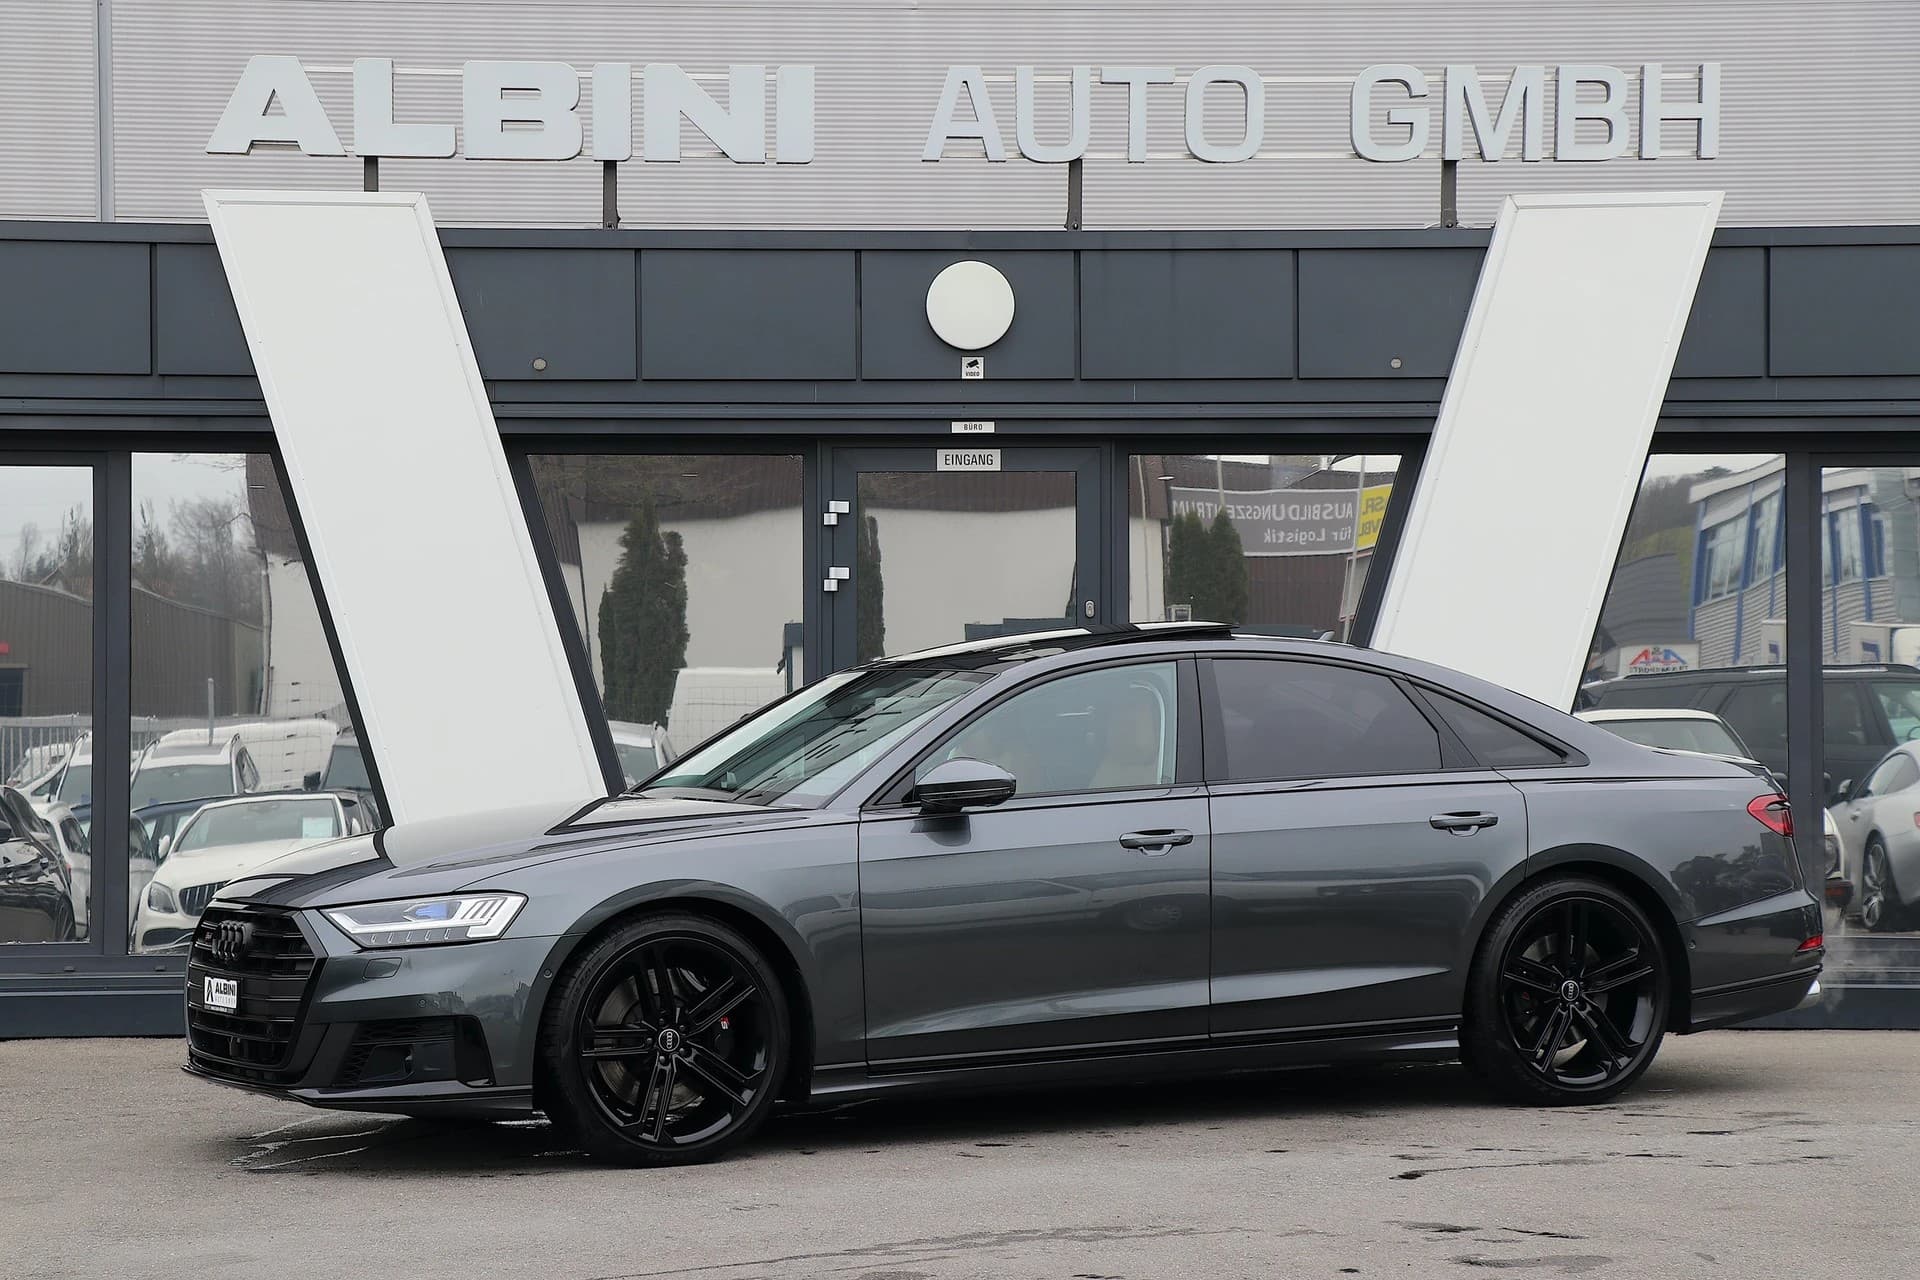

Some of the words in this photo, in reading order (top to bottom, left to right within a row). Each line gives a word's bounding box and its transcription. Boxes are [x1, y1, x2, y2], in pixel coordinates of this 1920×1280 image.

[205, 55, 815, 164] ALBINI
[921, 64, 1265, 164] AUTO
[1350, 62, 1721, 164] GMBH
[963, 423, 983, 431] BÜRO
[944, 454, 994, 466] EINGANG
[215, 981, 236, 997] ALBINI
